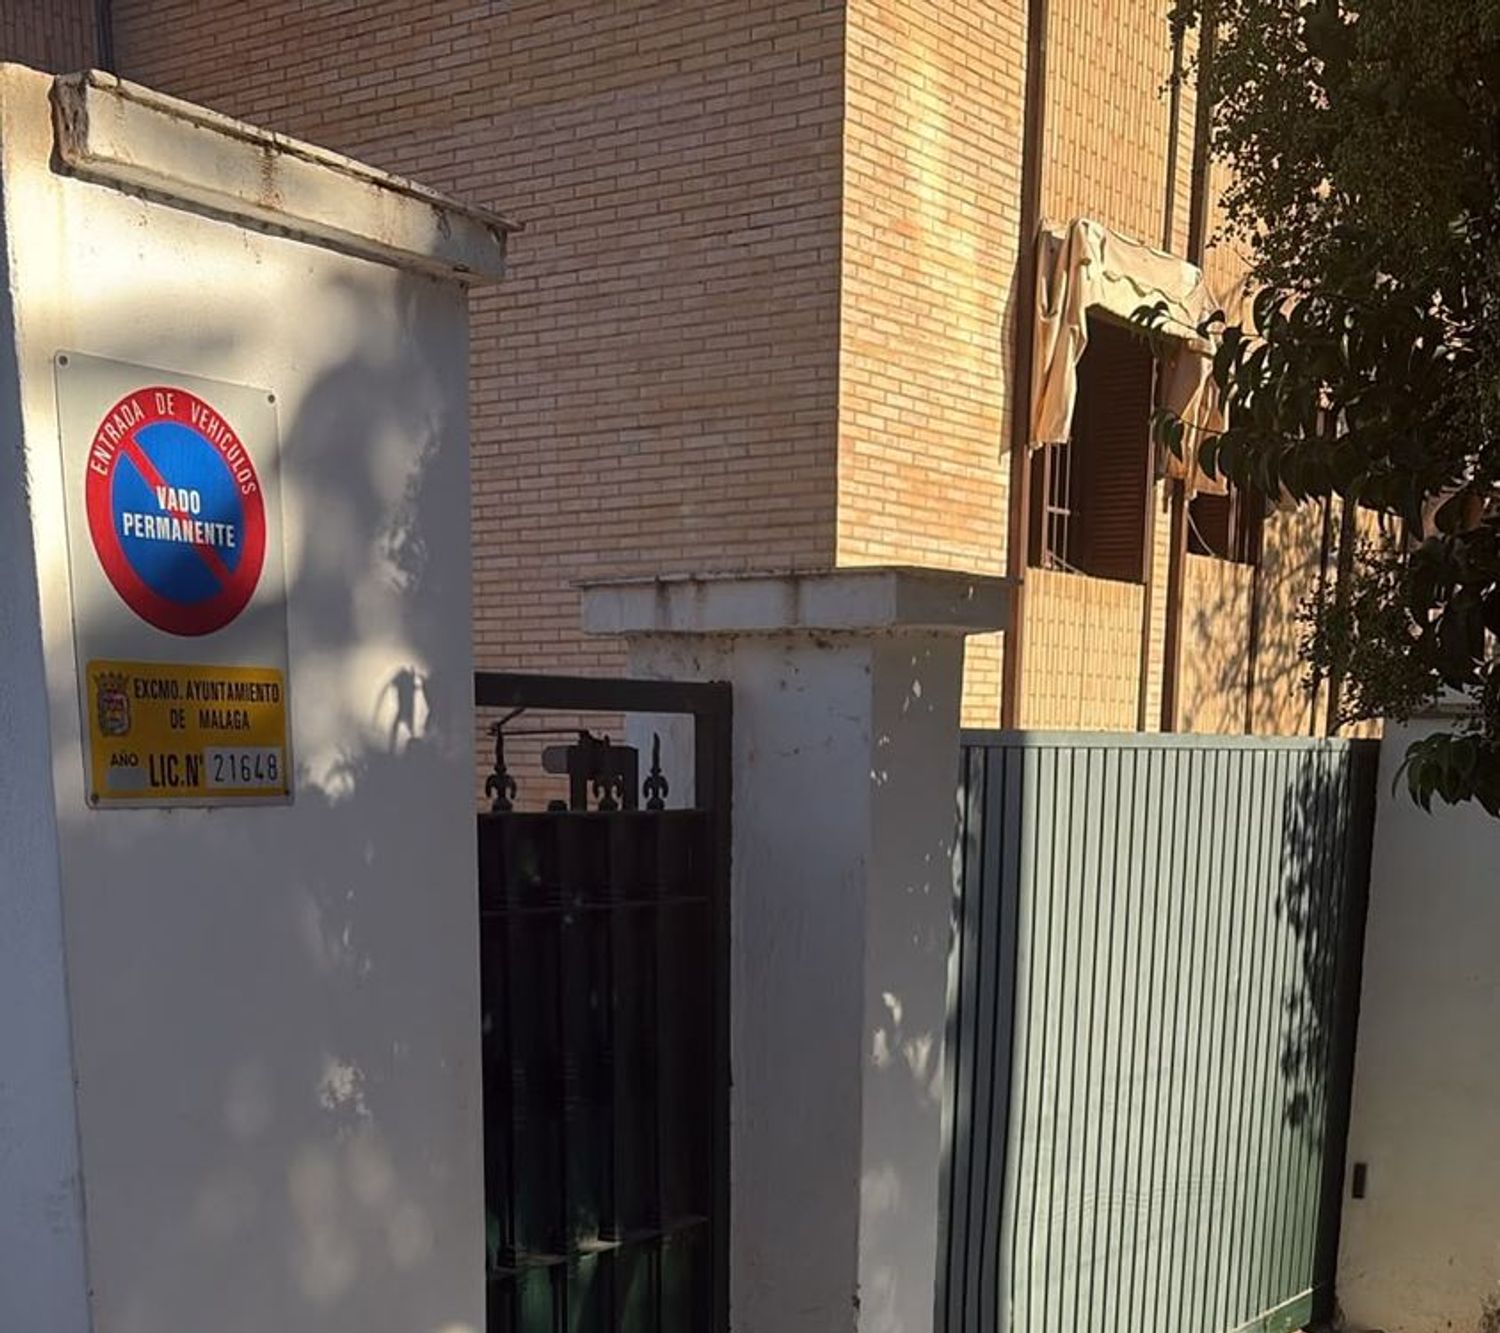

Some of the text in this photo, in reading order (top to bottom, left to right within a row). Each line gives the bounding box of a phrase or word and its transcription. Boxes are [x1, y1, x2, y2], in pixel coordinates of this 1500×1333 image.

[90, 392, 257, 496] ENTRADA DE VEHICULOS
[156, 486, 200, 514] VADO
[122, 512, 236, 548] PERMANENTE
[185, 679, 280, 703] AYUNTAMIENTO
[169, 708, 251, 730] DE MALAGA
[213, 753, 278, 783] 21648
